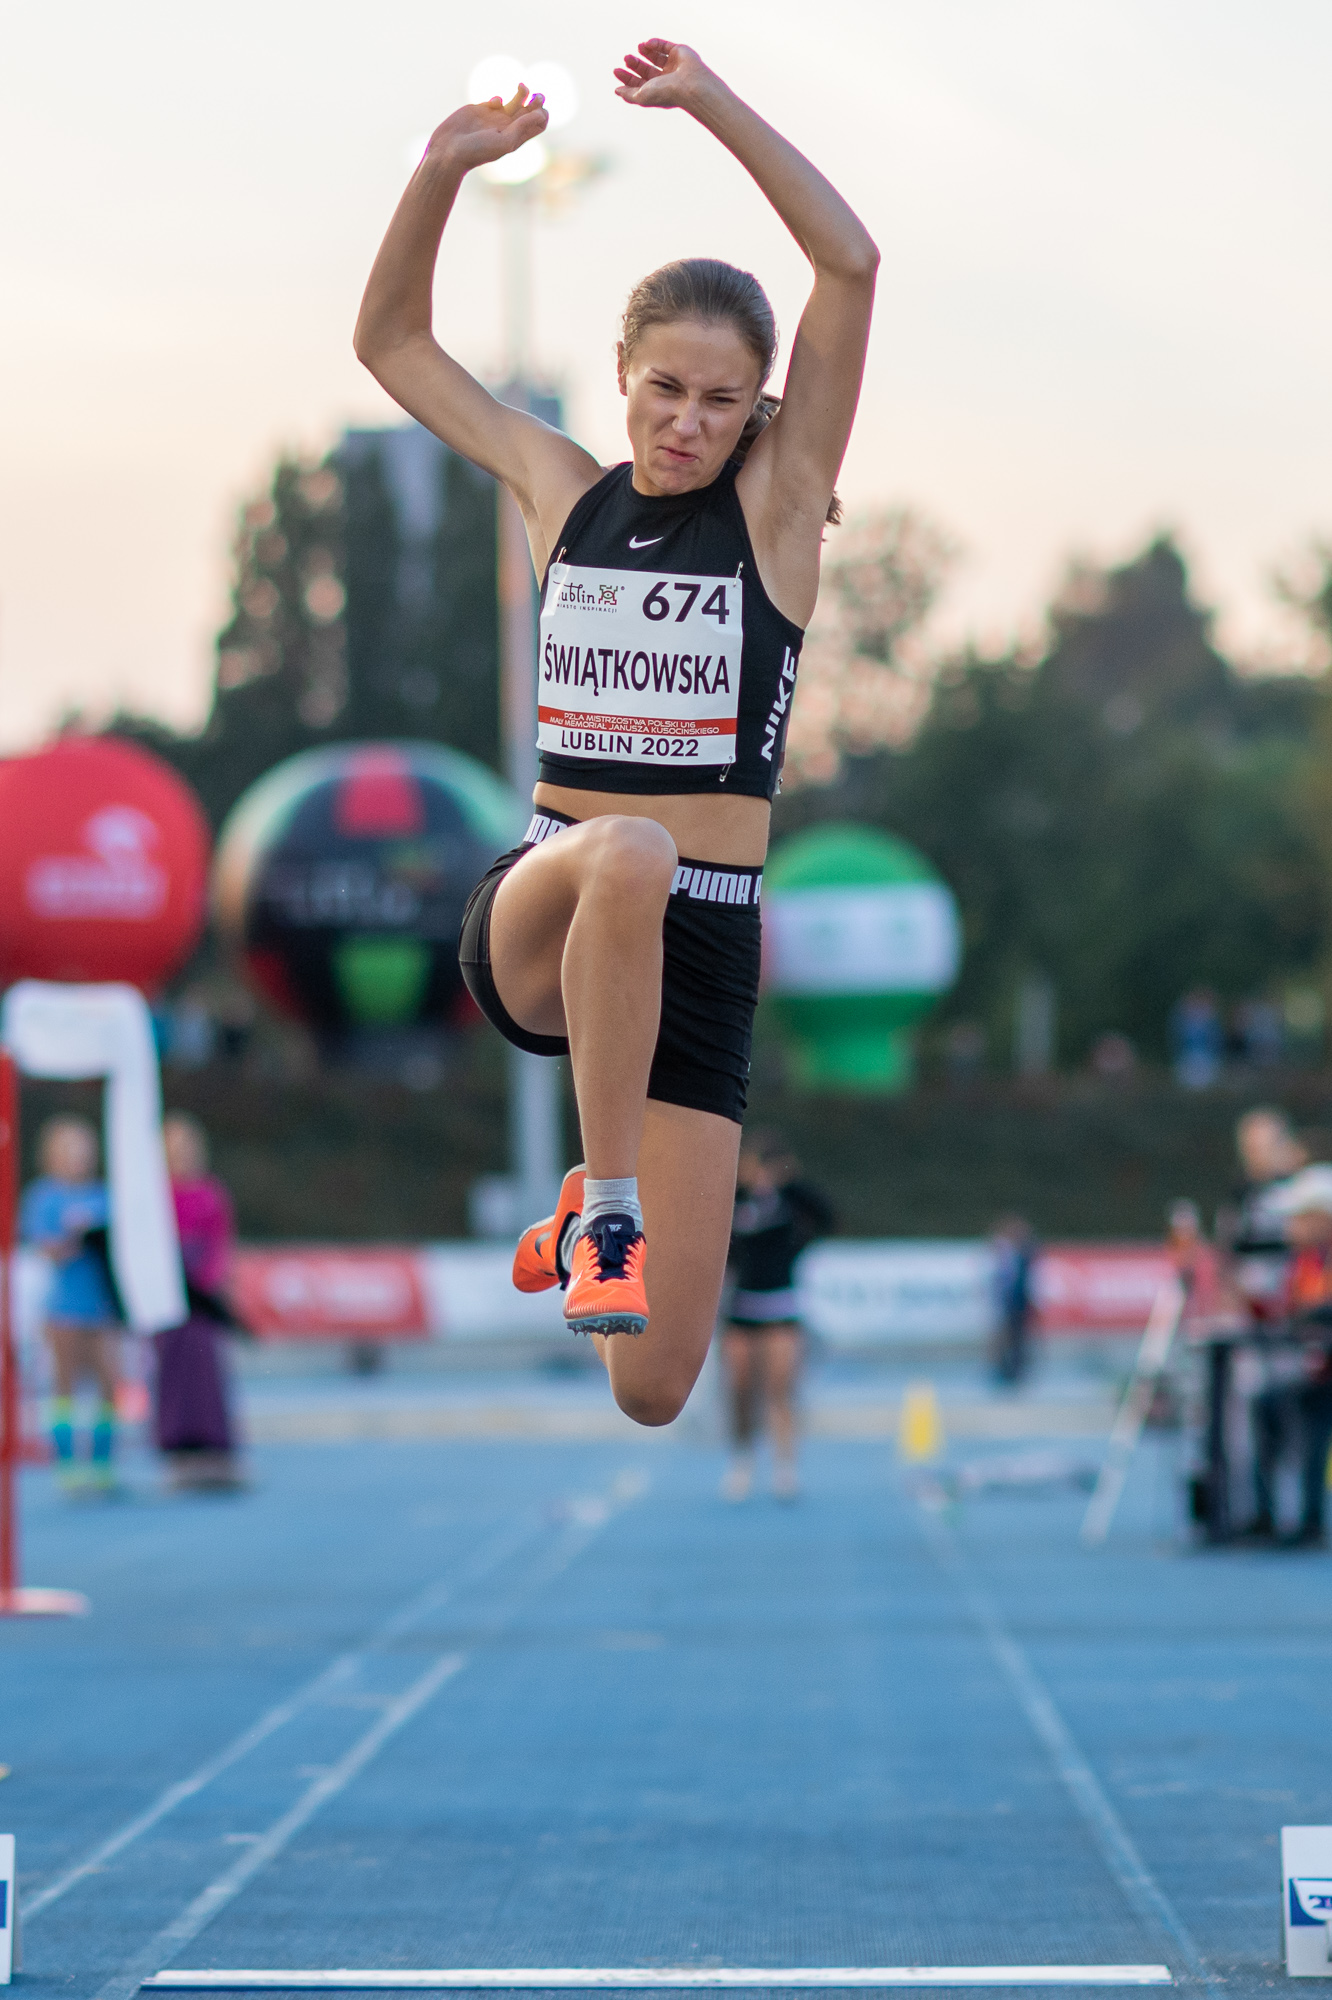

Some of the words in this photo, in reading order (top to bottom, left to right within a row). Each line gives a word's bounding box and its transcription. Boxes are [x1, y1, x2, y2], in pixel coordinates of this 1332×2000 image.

[553, 581, 595, 604] ublin
[642, 581, 730, 625] 674
[579, 605, 618, 614] INSPIRACJI
[544, 633, 730, 696] ŚWIĄTKOWSKA
[761, 645, 796, 762] NIKE
[564, 712, 585, 721] PZLA
[586, 714, 646, 726] MISTRZOSTWA
[647, 719, 679, 728] POLSKI
[680, 721, 696, 729] U16
[564, 719, 608, 730] MEMORIAŁ
[608, 724, 650, 733] JANUSZA
[561, 729, 633, 754] LUBLIN
[641, 737, 699, 757] 2022
[669, 865, 752, 905] PUMA
